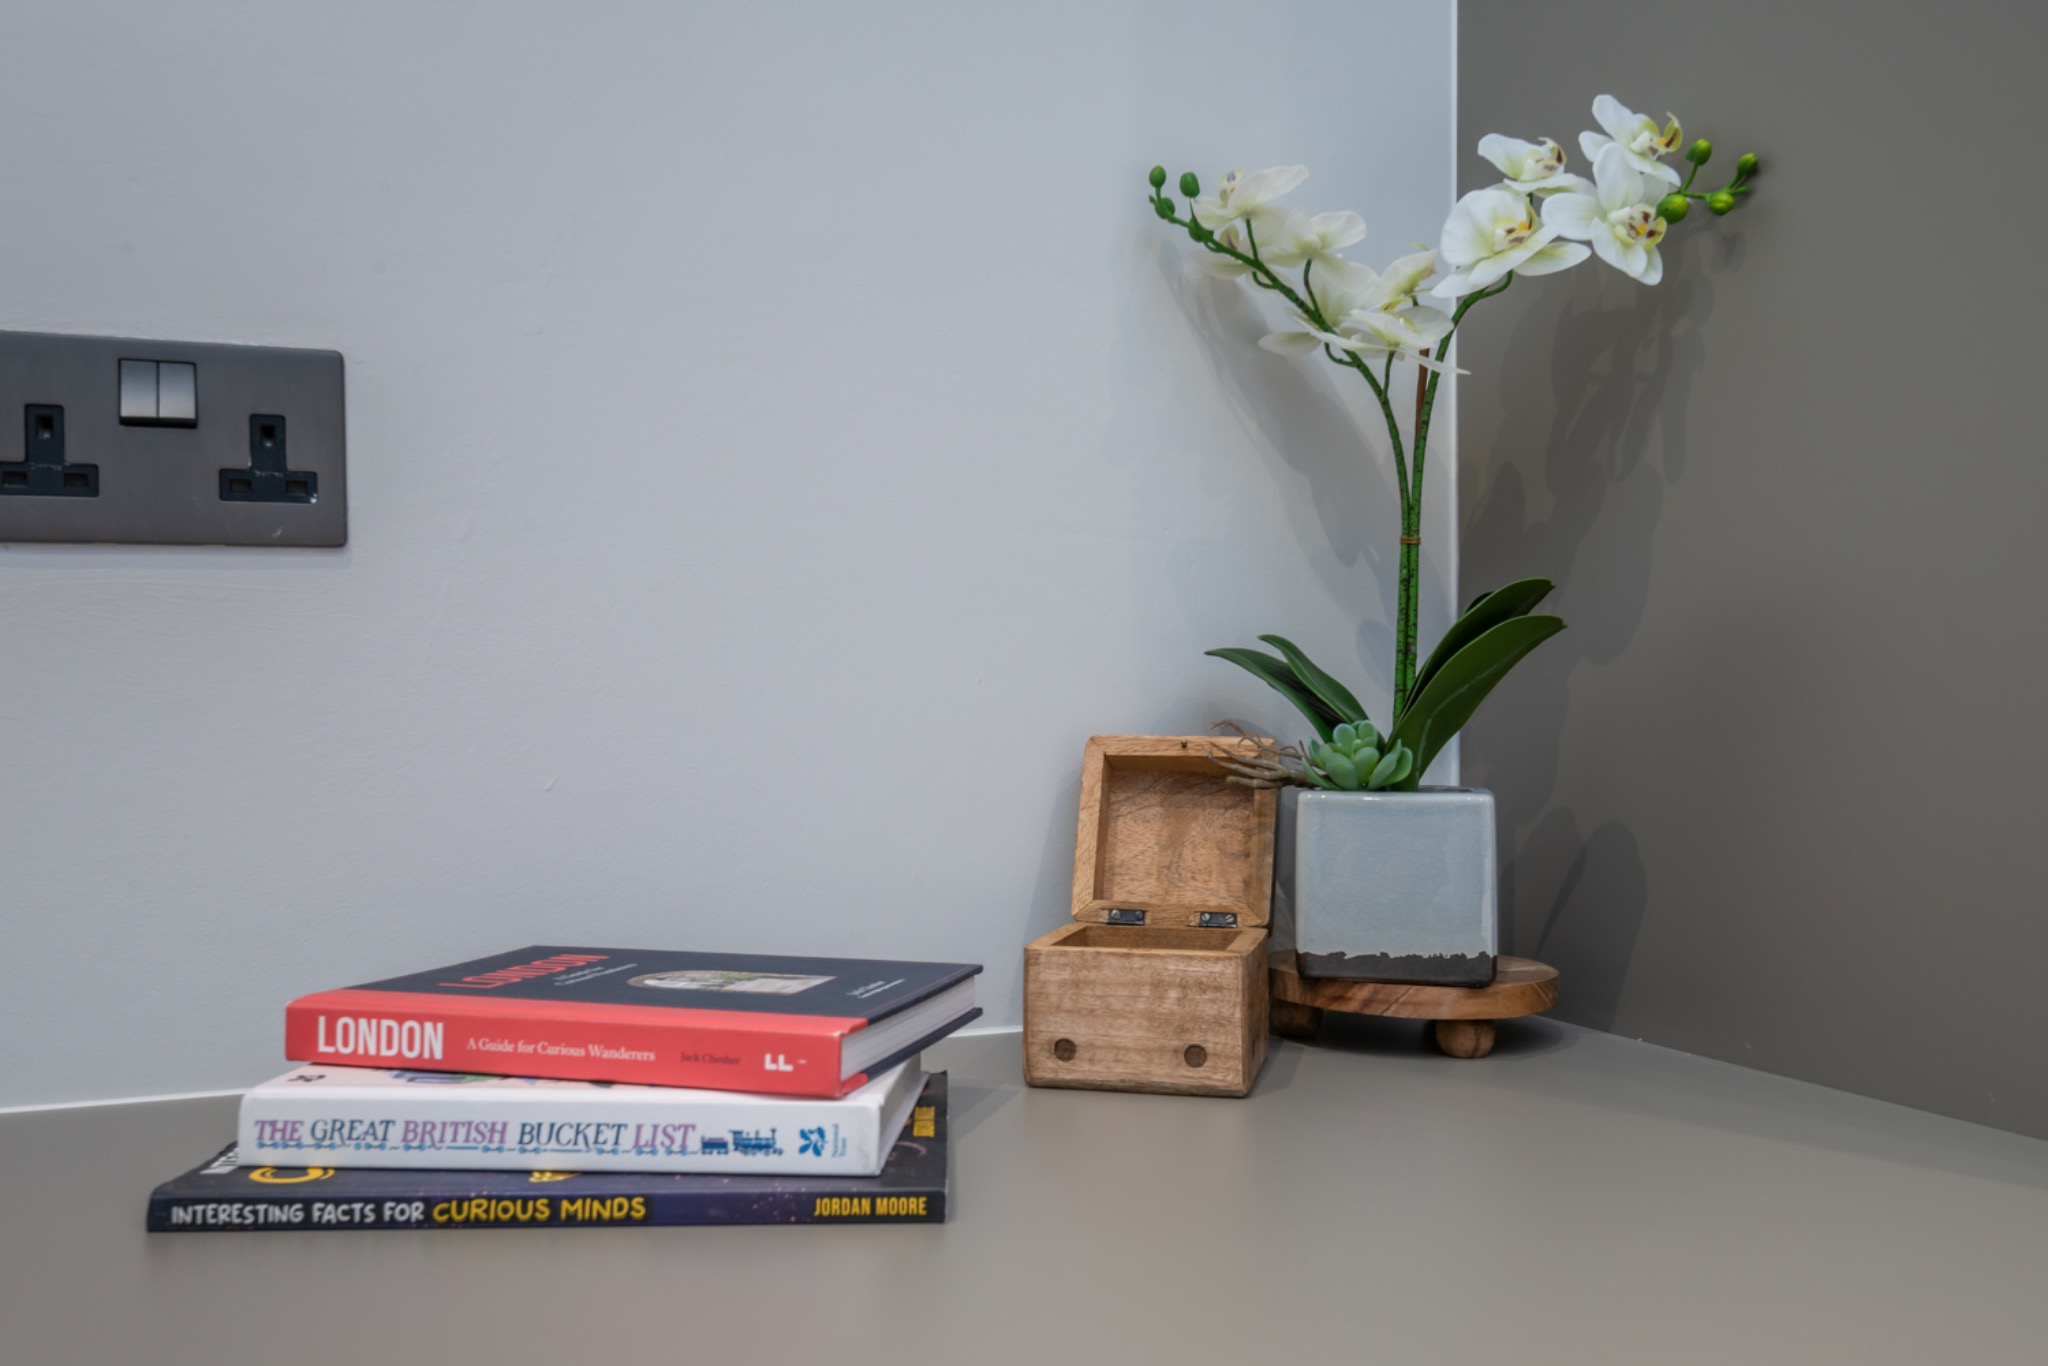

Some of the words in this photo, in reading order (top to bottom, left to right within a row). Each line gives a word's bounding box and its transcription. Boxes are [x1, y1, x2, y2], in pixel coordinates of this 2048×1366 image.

[436, 953, 610, 989] LONDON
[317, 1015, 445, 1060] LONDON
[465, 1037, 478, 1050] A
[478, 1038, 515, 1053] Guide
[517, 1039, 536, 1054] for
[537, 1041, 586, 1057] Curious
[588, 1043, 657, 1062] Wanderers
[680, 1051, 700, 1063] Jack
[254, 1119, 304, 1142] THE
[310, 1118, 396, 1146] GREAT
[402, 1119, 509, 1148] BRITISH
[518, 1121, 628, 1149] BUCKET
[633, 1123, 696, 1150] LIST
[170, 1202, 305, 1225] INTERESTING
[311, 1201, 377, 1224] FACTS
[383, 1200, 426, 1223] FOR
[432, 1197, 552, 1224] CURIOUS
[559, 1196, 647, 1222] MINDS
[814, 1196, 871, 1217] JORDAN
[875, 1196, 928, 1216] MOORE
